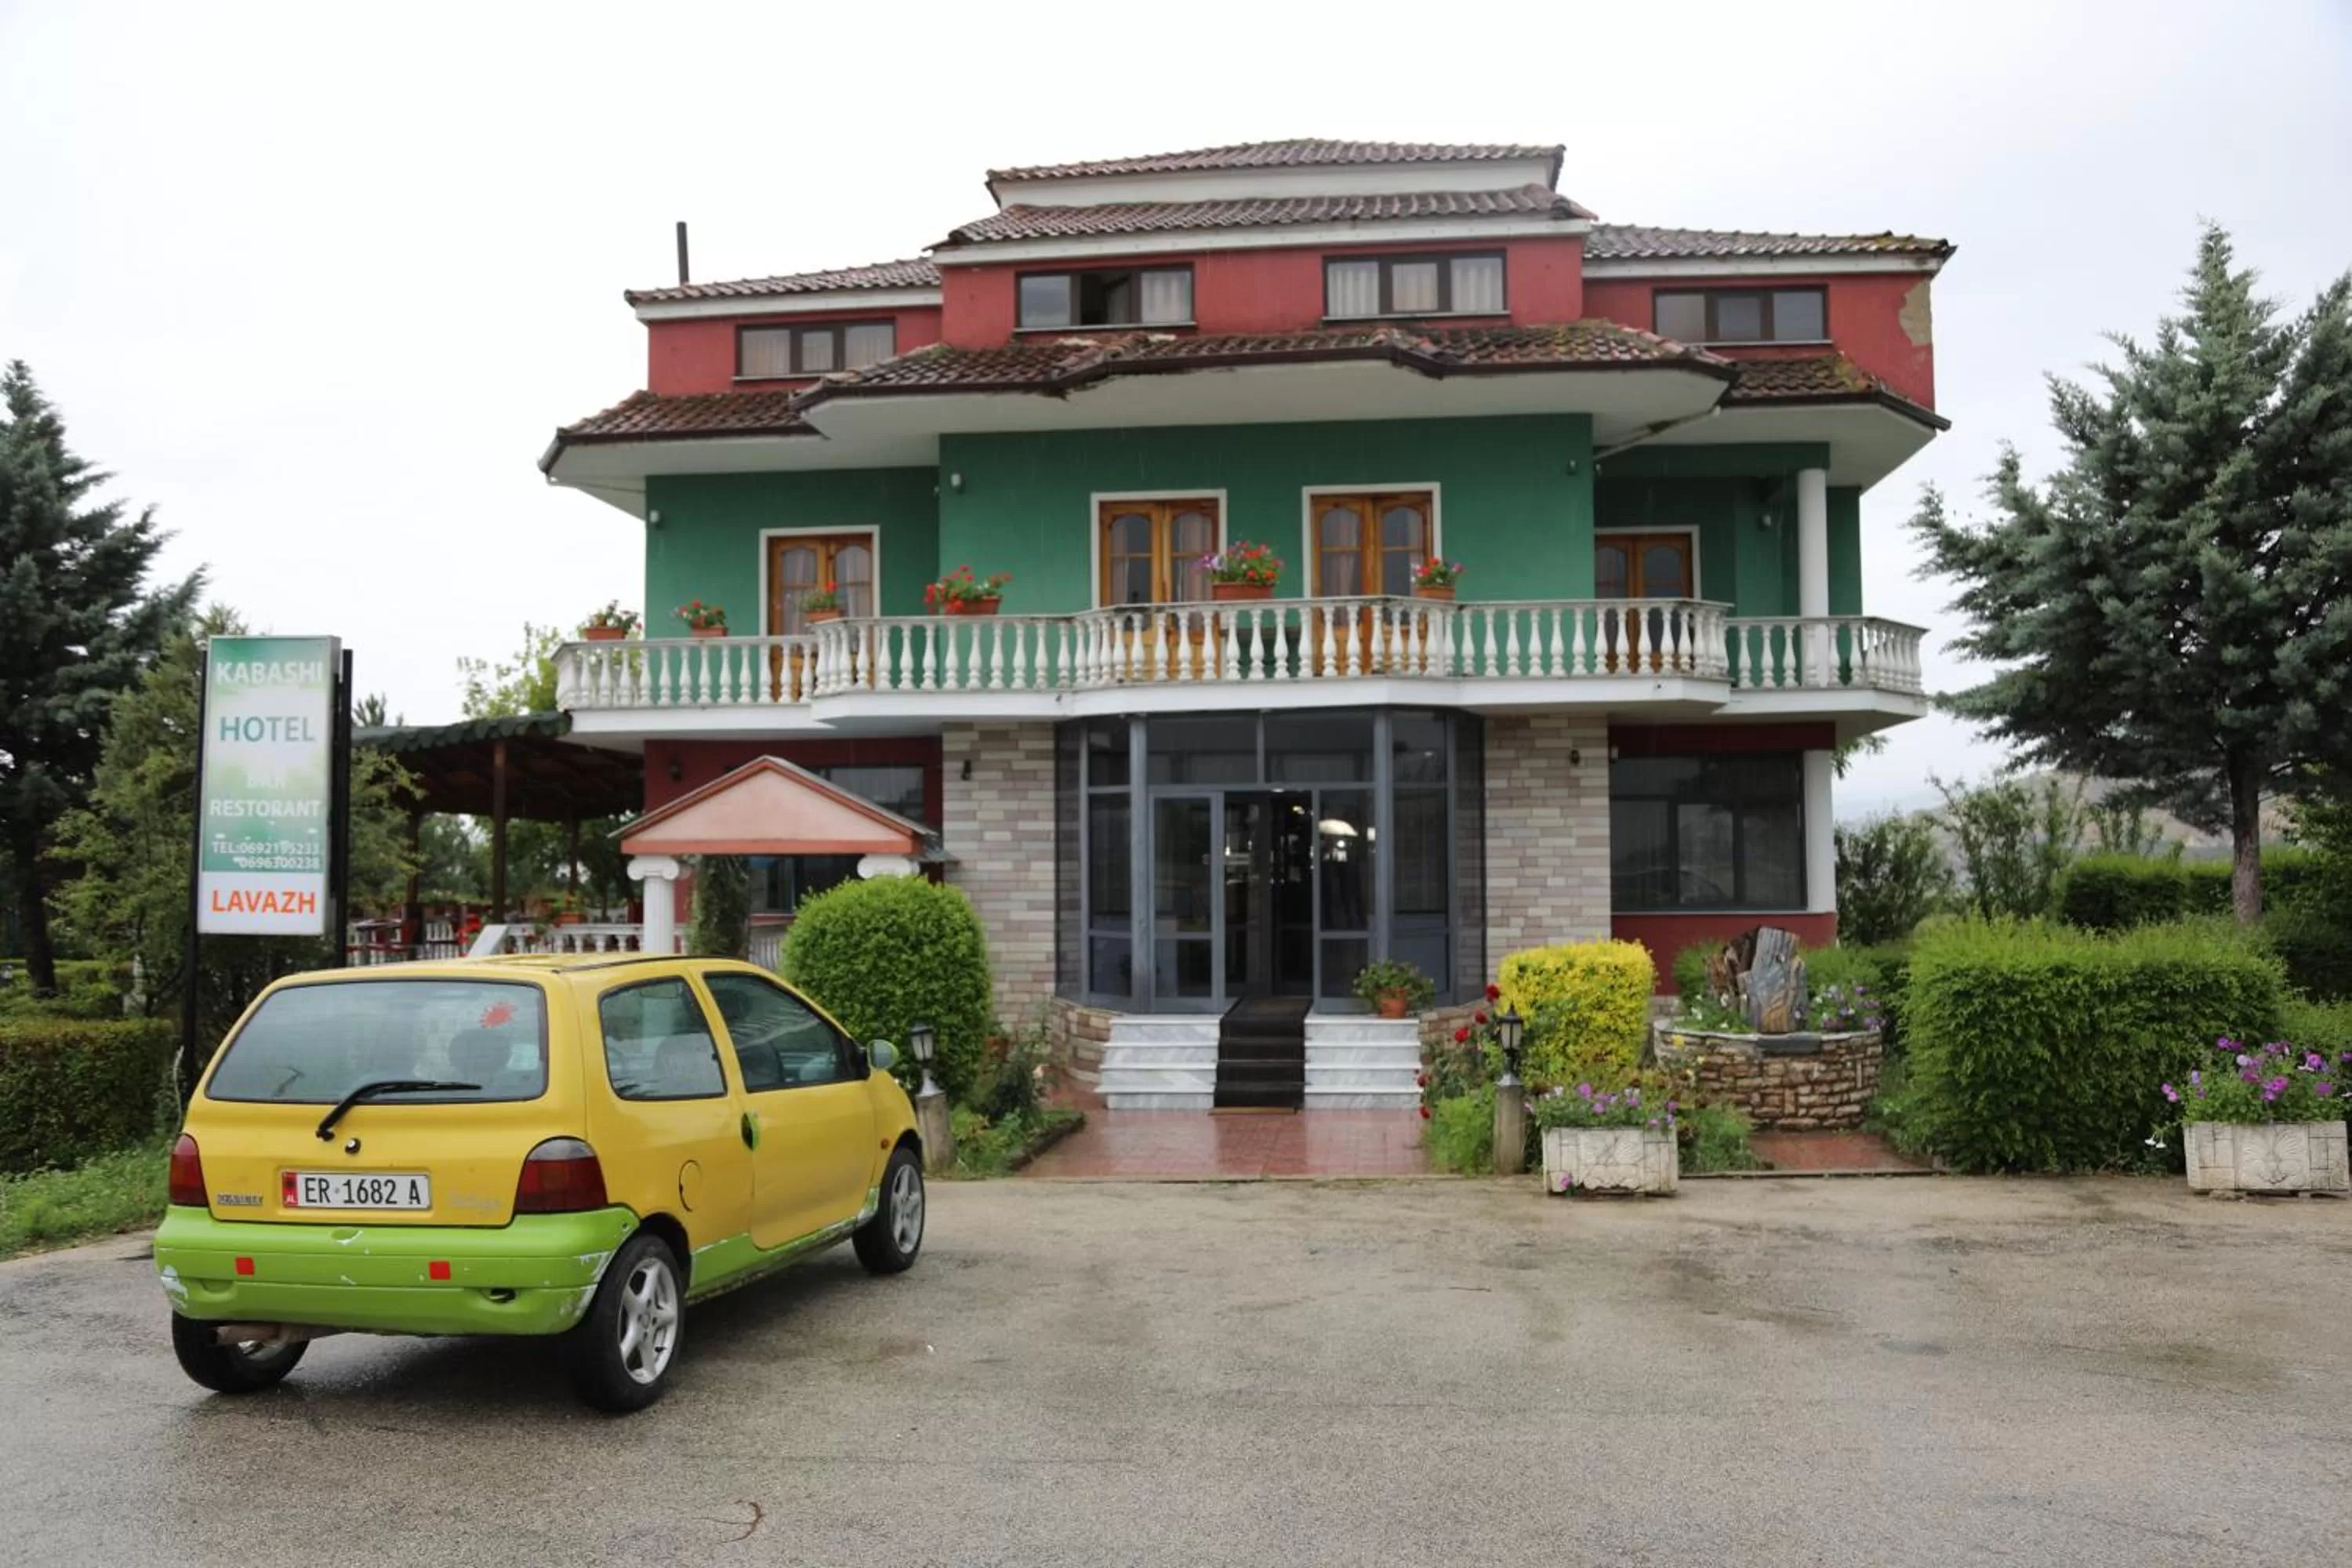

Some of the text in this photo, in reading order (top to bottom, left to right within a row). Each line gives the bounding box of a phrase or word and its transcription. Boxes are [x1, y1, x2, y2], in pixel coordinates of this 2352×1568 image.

[215, 661, 323, 684] KABASHI
[220, 716, 317, 742] HOTEL
[209, 799, 321, 816] RESTORANT
[211, 891, 314, 914] LAVAZH
[304, 1177, 331, 1203] ER
[343, 1179, 397, 1205] 1682
[408, 1179, 421, 1205] A
